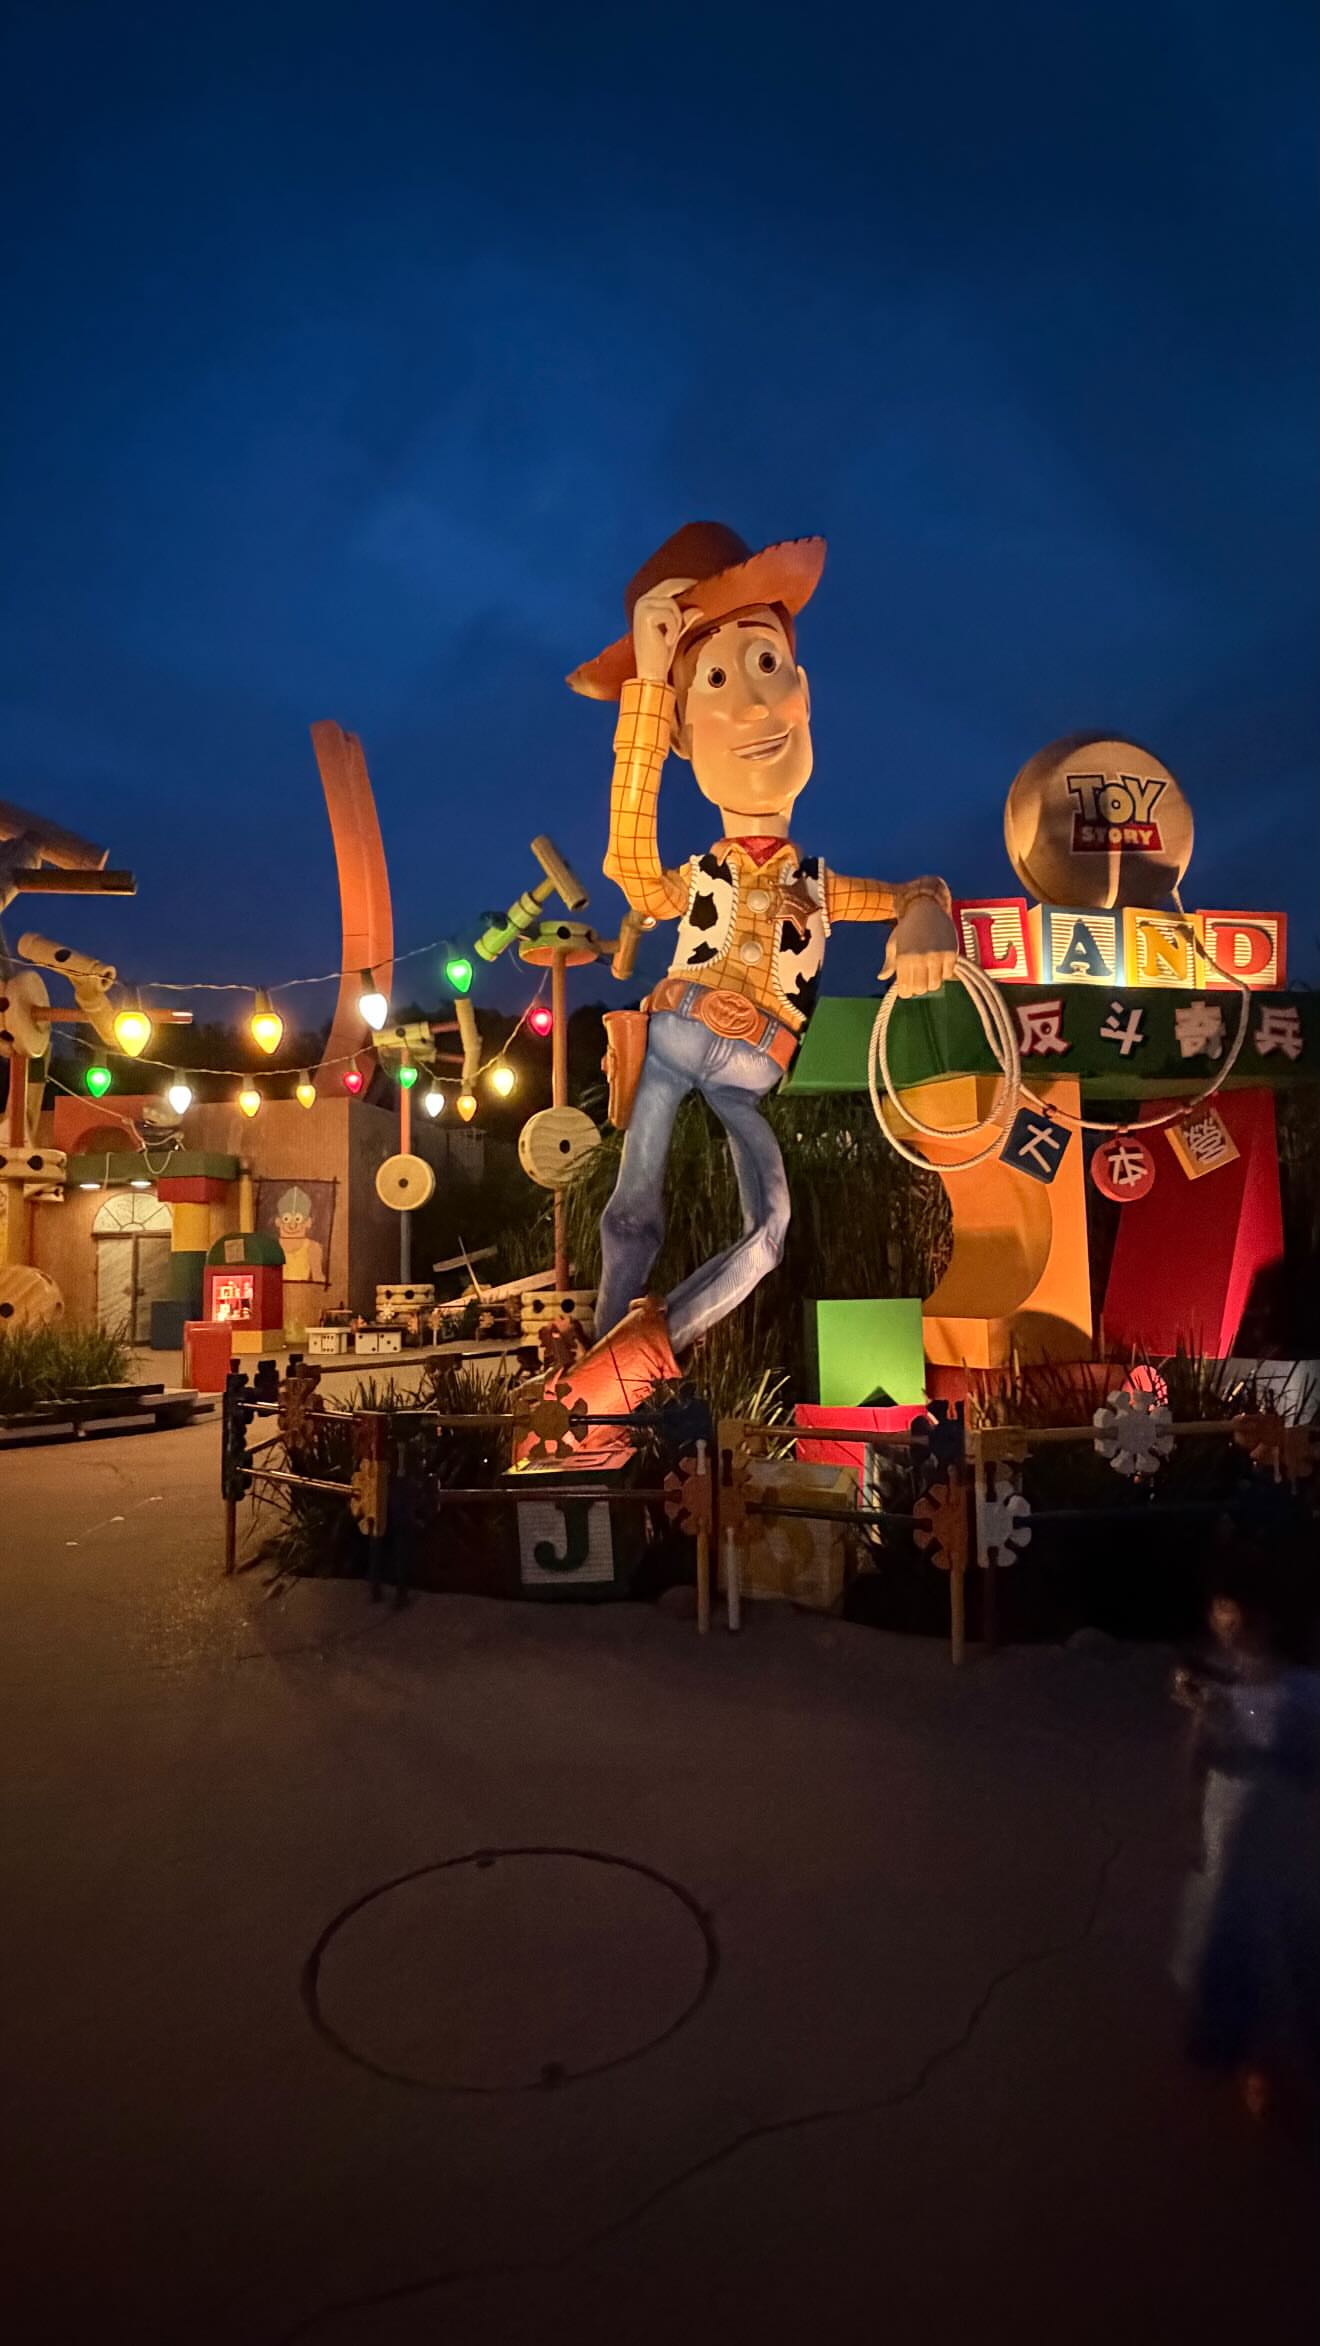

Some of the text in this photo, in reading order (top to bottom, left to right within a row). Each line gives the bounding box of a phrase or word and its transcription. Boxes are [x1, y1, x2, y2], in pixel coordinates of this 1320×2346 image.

[1066, 775, 1167, 824] TOY
[1081, 826, 1154, 846] STORY
[965, 912, 1273, 978] LAND
[533, 1498, 594, 1572] J
